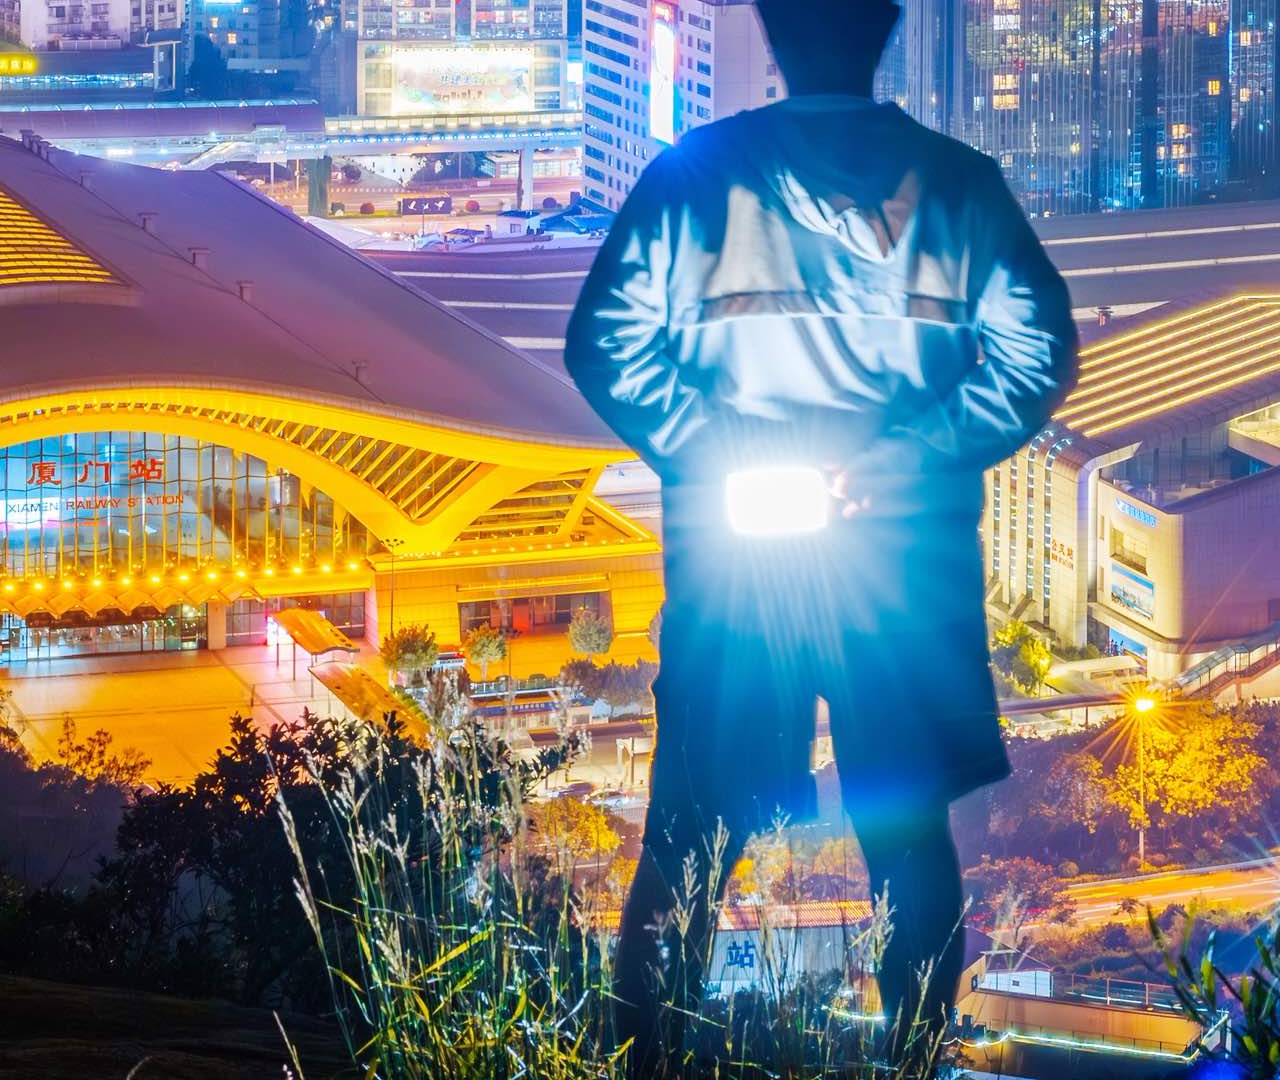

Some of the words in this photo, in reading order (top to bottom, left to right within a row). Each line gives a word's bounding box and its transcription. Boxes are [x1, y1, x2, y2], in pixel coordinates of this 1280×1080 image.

[26, 457, 165, 486] 厦门站
[8, 500, 59, 514] XIAMEN
[66, 497, 121, 511] RAILWAY
[726, 940, 756, 968] 站
